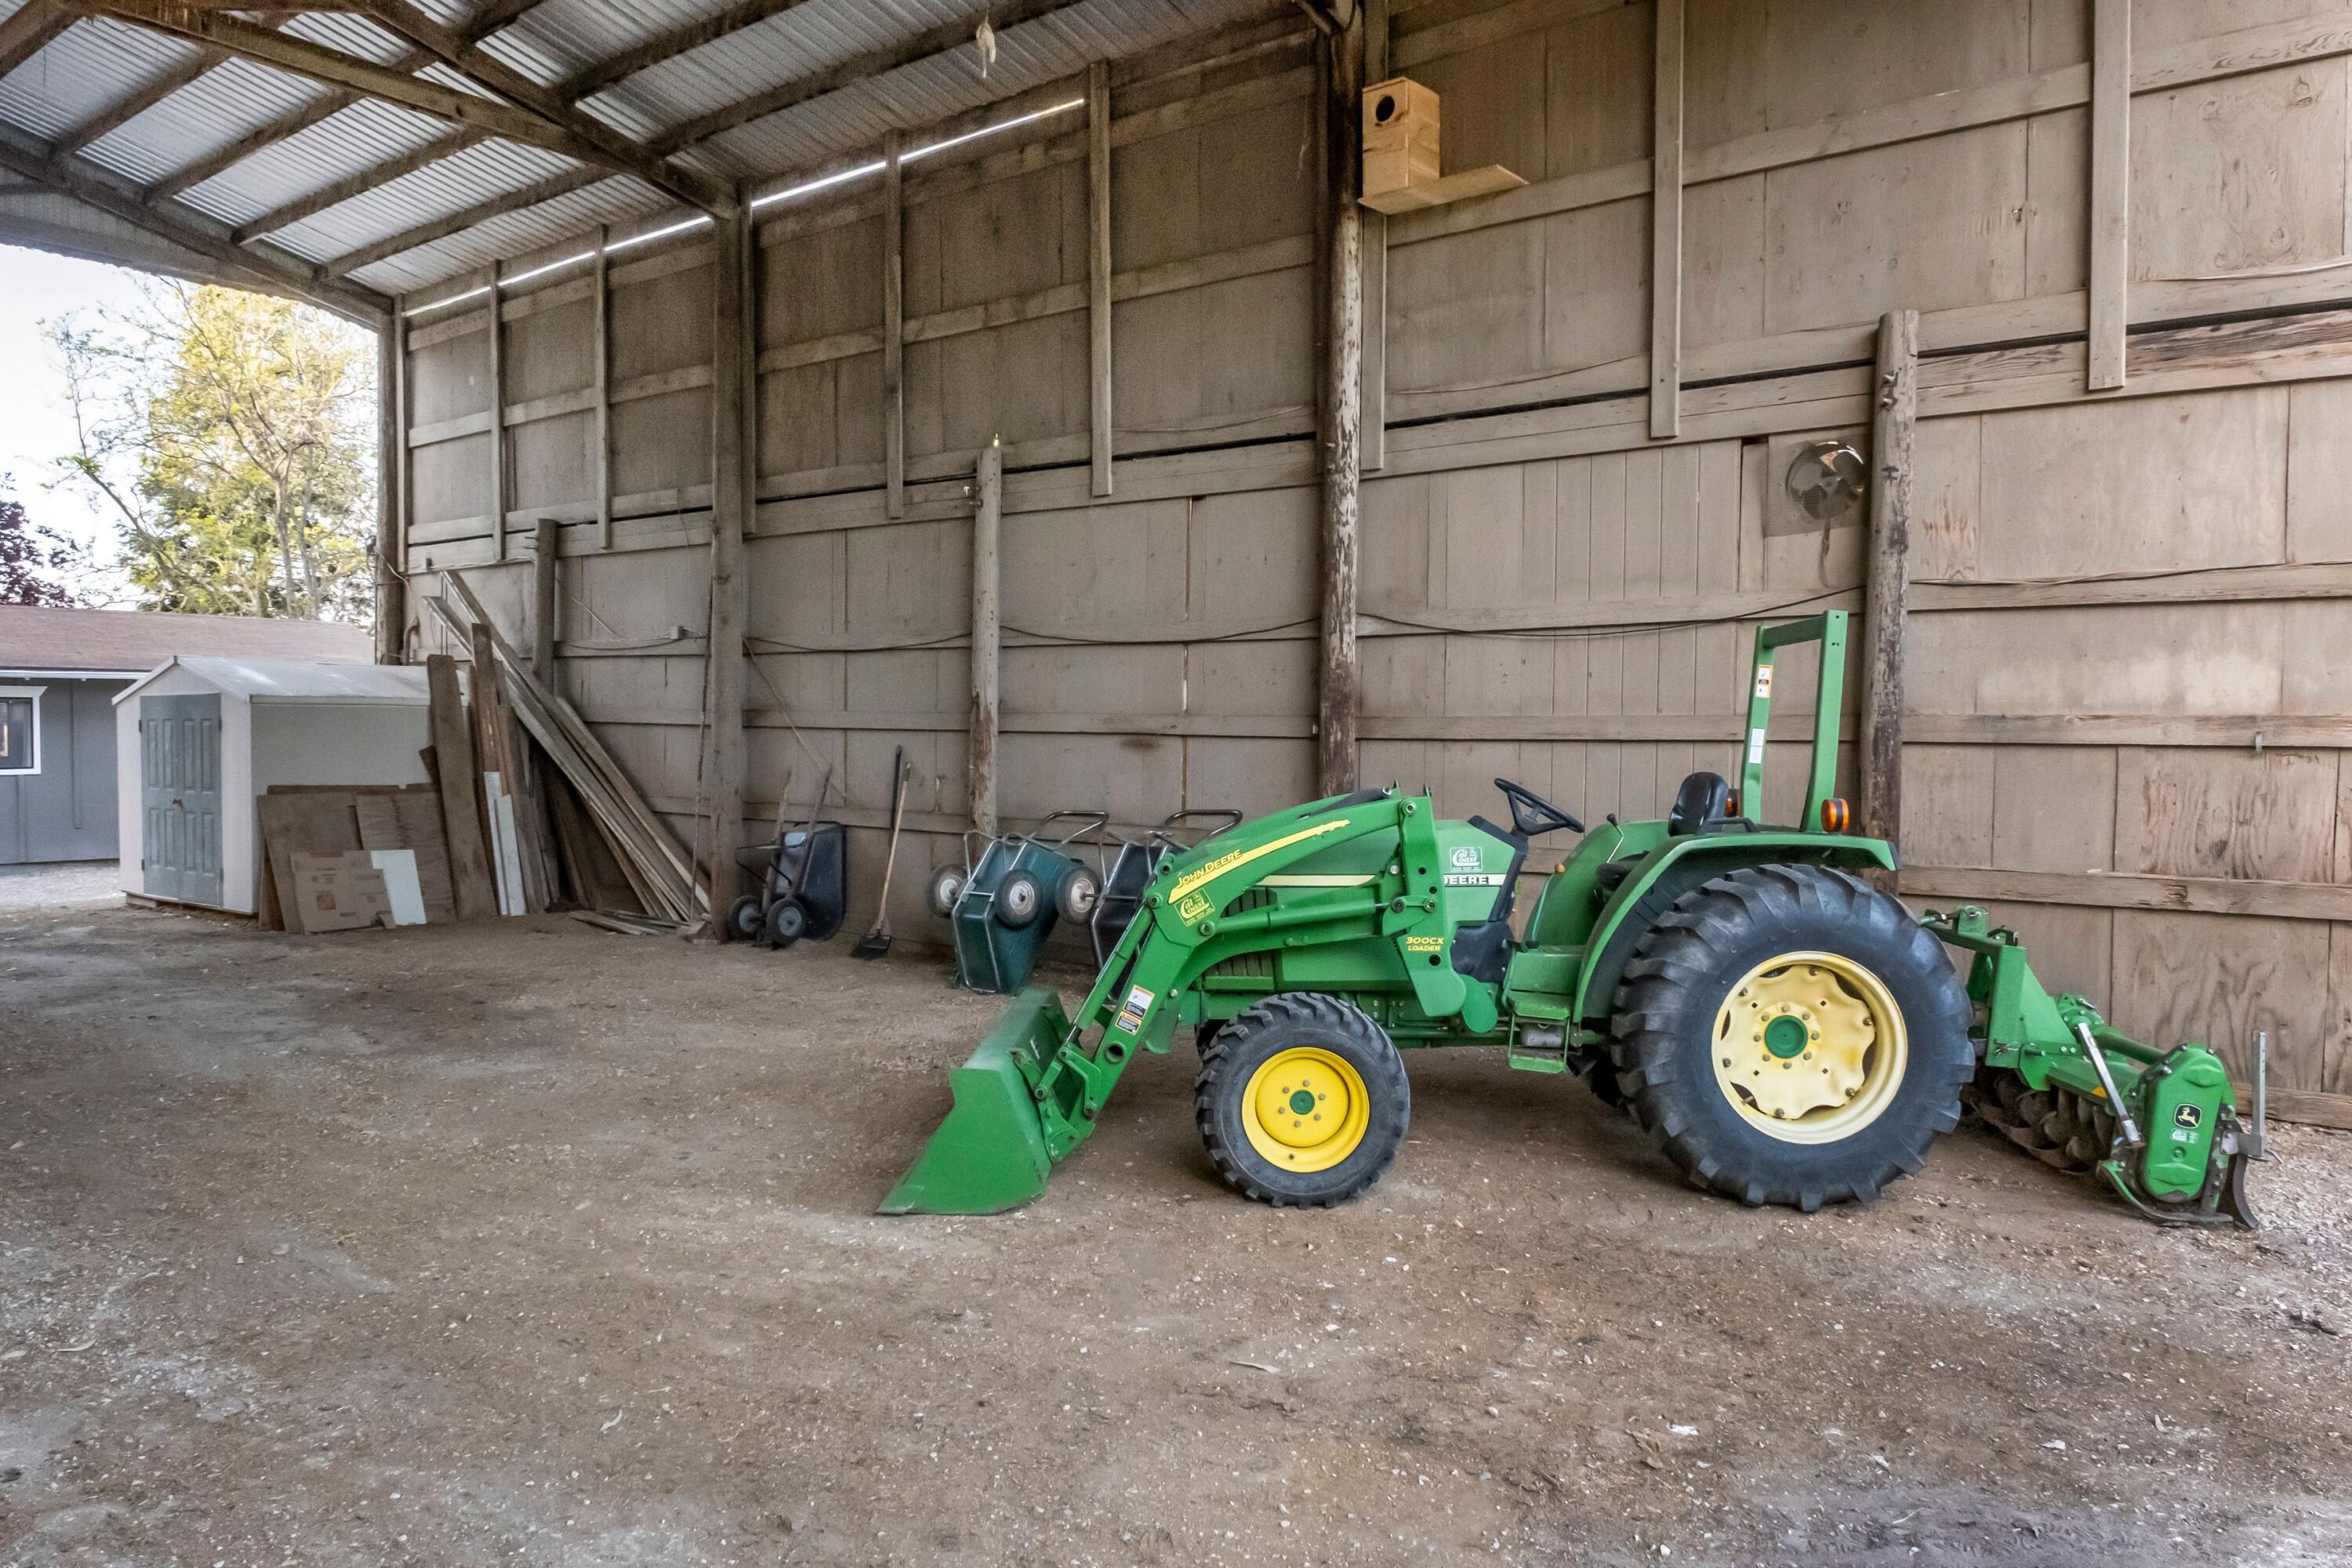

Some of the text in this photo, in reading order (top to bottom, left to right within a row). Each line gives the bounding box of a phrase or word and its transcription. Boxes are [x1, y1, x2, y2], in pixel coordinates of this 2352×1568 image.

[1178, 848, 1243, 888] JOHN DEERE
[1406, 936, 1444, 945] 300CX
